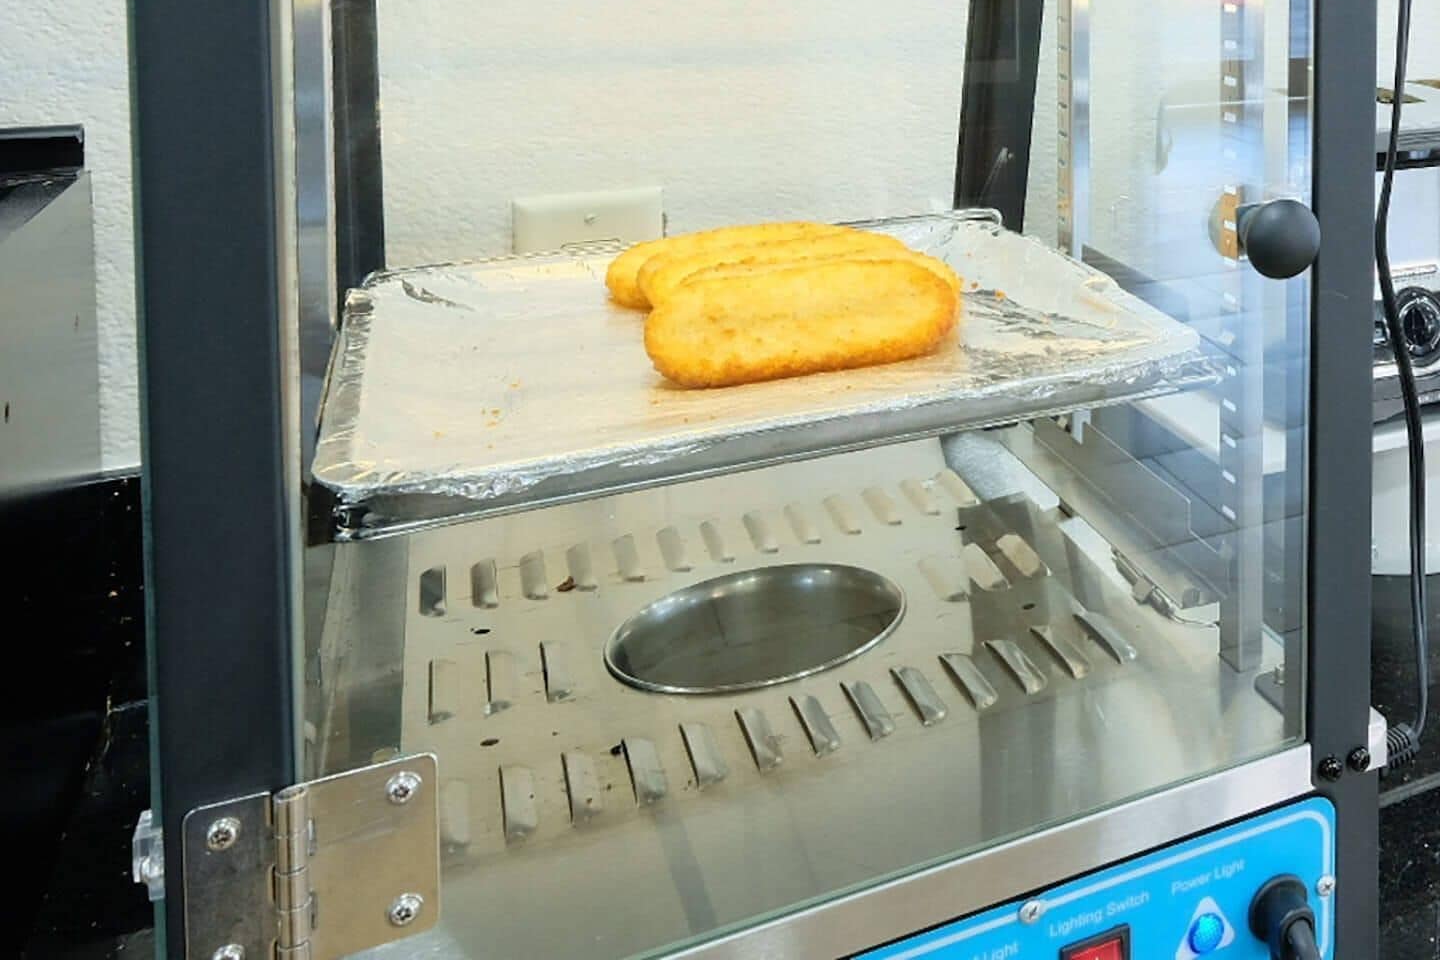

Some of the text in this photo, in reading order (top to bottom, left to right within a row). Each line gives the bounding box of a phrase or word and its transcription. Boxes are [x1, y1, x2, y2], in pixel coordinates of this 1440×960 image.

[1171, 859, 1246, 896] Power Light
[1050, 891, 1150, 937] Lighting Switch
